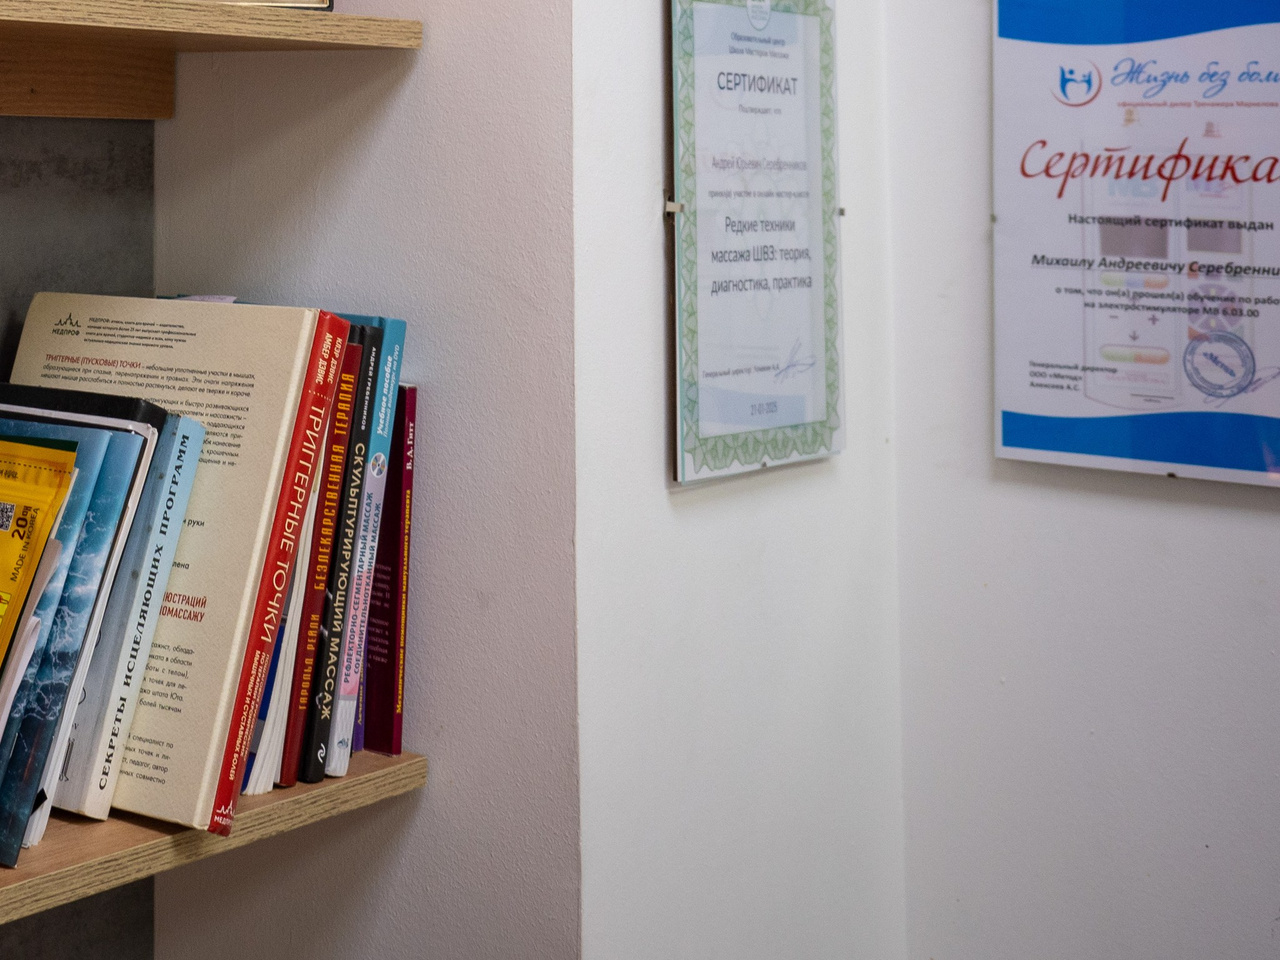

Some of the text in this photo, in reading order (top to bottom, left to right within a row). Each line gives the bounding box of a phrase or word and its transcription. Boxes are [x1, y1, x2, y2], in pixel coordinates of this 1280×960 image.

[717, 72, 798, 95] СЕРТИФИКАТ
[1110, 57, 1190, 99] Жизнь
[1197, 61, 1231, 99] без
[725, 216, 795, 235] Редкие техники
[1068, 213, 1274, 232] Настоящий сертификат выдан
[711, 247, 811, 263] массажа теория,
[1031, 254, 1095, 270] Михаилу
[1097, 256, 1186, 274] Андреевичу
[711, 276, 812, 296] диагностика, практика
[52, 328, 80, 336] МЕДПРОФ
[46, 353, 141, 369] ТРИГГЕРНЫЕ ТОЧКИ
[316, 332, 333, 385] АМБЕР ДЭВИС
[377, 355, 393, 435] Учебное пособие
[314, 373, 355, 591] БЕЗЛЕКАРСТВЕННАЯ ТЕРАПИЯ
[260, 405, 326, 643] ТРИГГЕРНЫЕ ТОЧКИ
[370, 502, 382, 544] МАССАЖ
[10, 507, 40, 582] MADE IN KOREA
[320, 442, 366, 720] СКУЛЬПТУРИРУЮЩИЙ МАССАЖ
[343, 491, 374, 684] РЕФЛЕКТОРНО-СЕГМЕНТАРНЫЙ МАССАЖ
[98, 434, 190, 790] СЕКРЕТЫ ИСЦЕЛЯЮЩИХ ПРОГРАММ
[160, 606, 205, 622] ОМАССАЖУ
[163, 592, 207, 609] ЮСТРАЦИЙ
